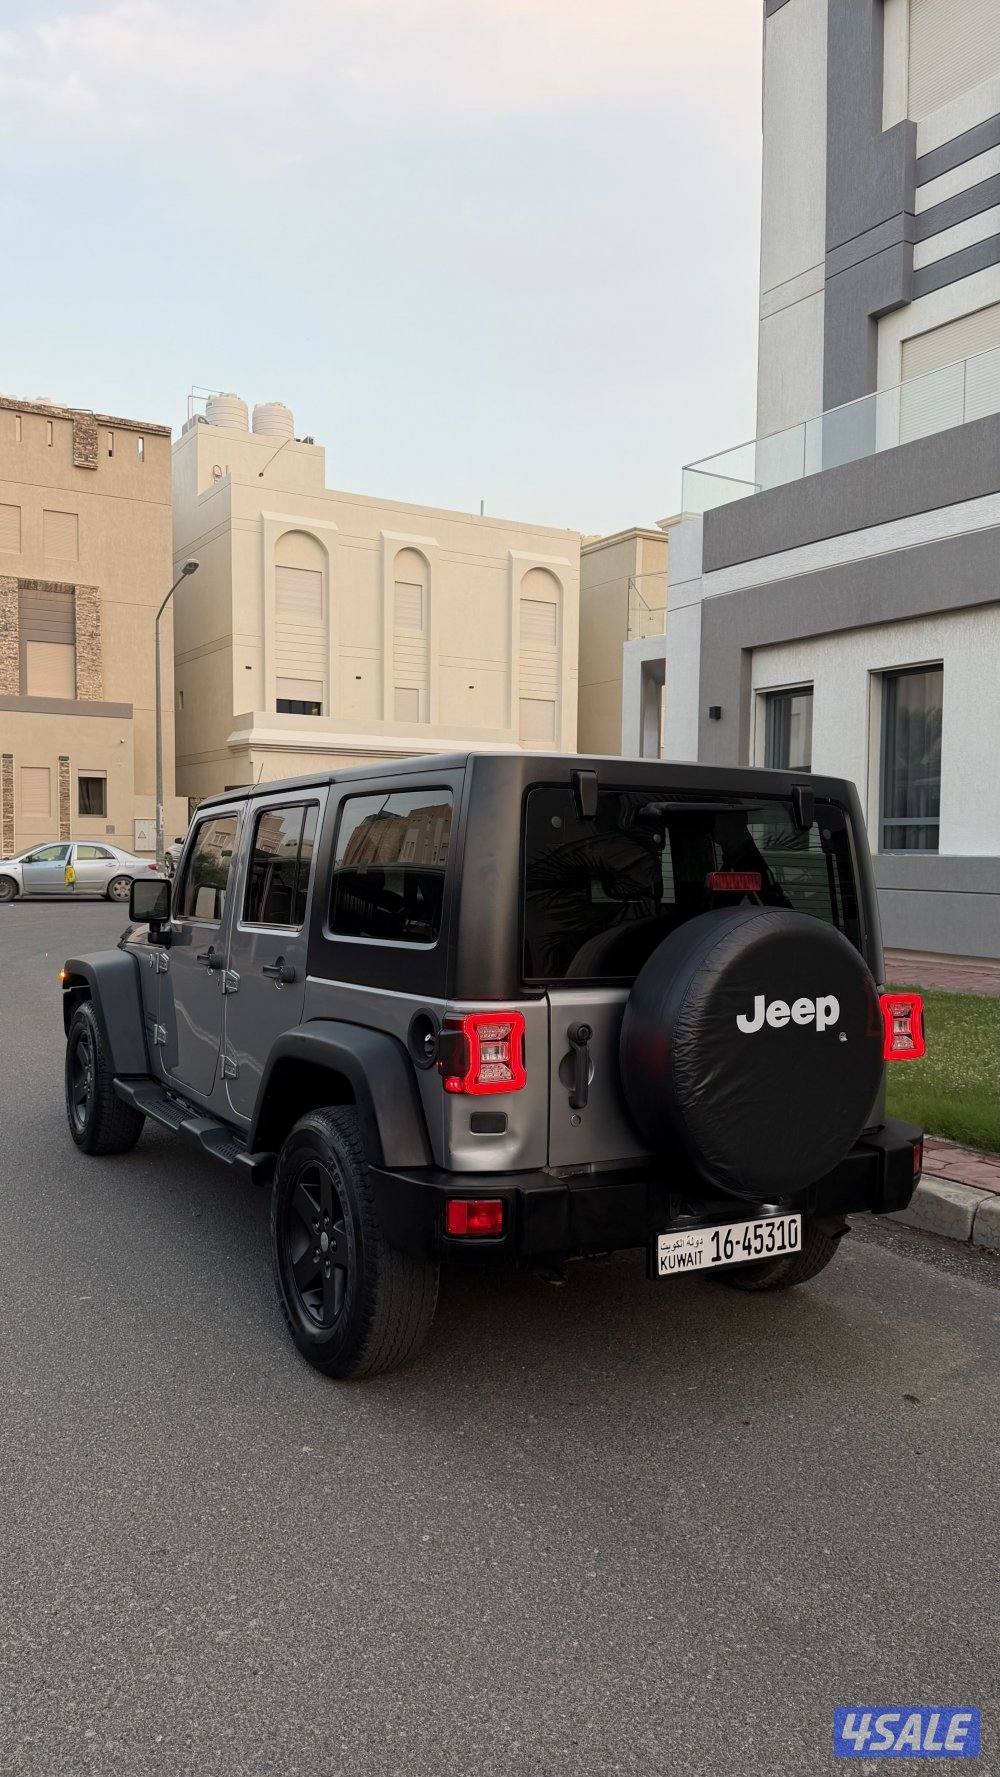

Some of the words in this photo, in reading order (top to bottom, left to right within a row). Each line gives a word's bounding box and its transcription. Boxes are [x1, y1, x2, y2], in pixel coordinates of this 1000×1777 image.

[736, 995, 840, 1034] Jeep
[660, 1239, 685, 1252] الكويت
[686, 1235, 704, 1248] دولة
[711, 1218, 798, 1263] 16-45310
[660, 1250, 704, 1271] KUWAIT
